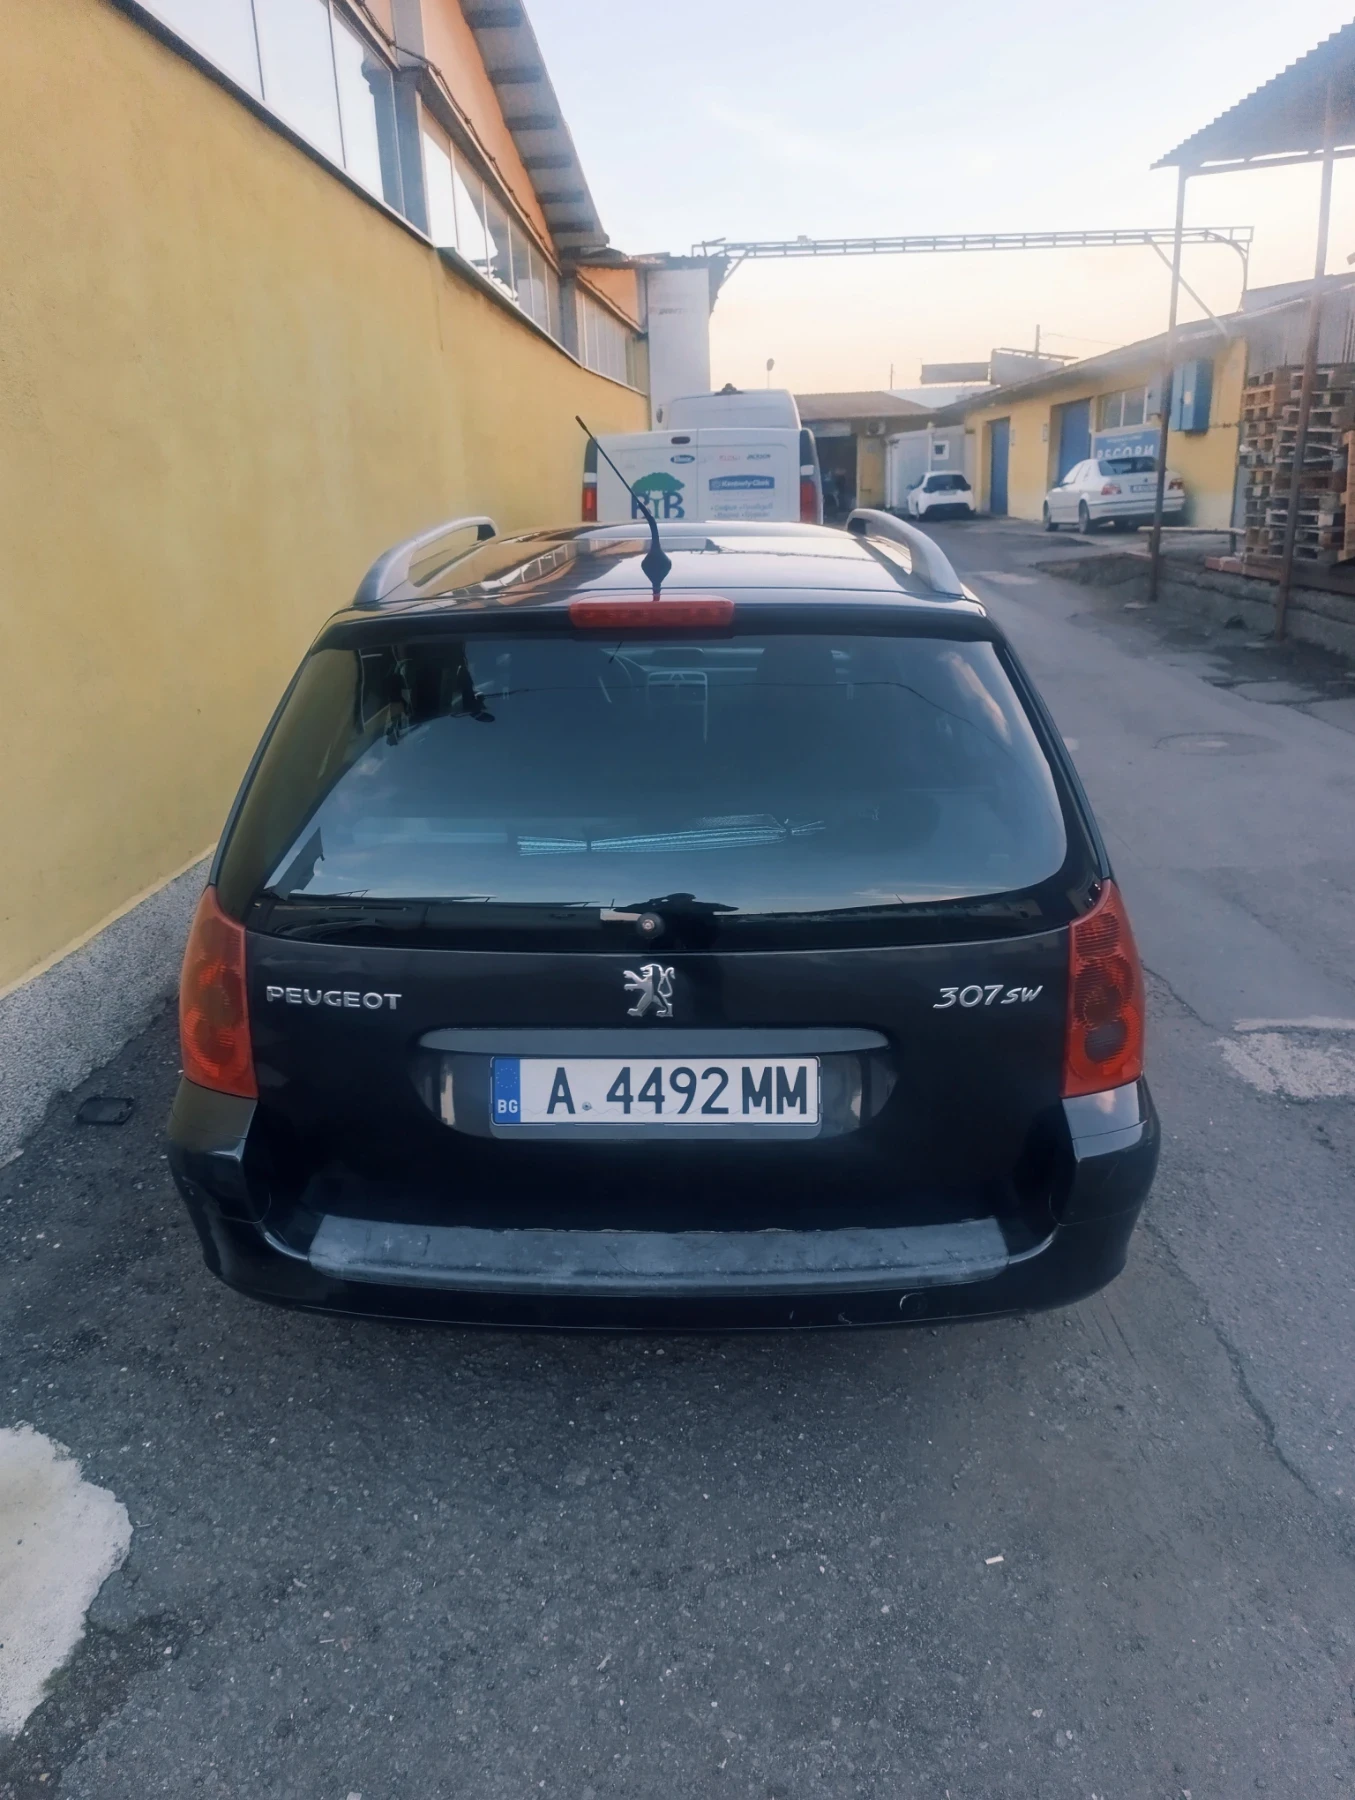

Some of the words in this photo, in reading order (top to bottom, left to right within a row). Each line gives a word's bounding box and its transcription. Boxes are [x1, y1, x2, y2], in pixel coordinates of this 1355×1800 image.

[266, 985, 403, 1010] PEUGEOT
[932, 984, 1005, 1009] 307
[546, 1066, 576, 1115] A
[606, 1066, 729, 1115] 4492
[741, 1066, 808, 1115] MM
[497, 1099, 518, 1114] BG
